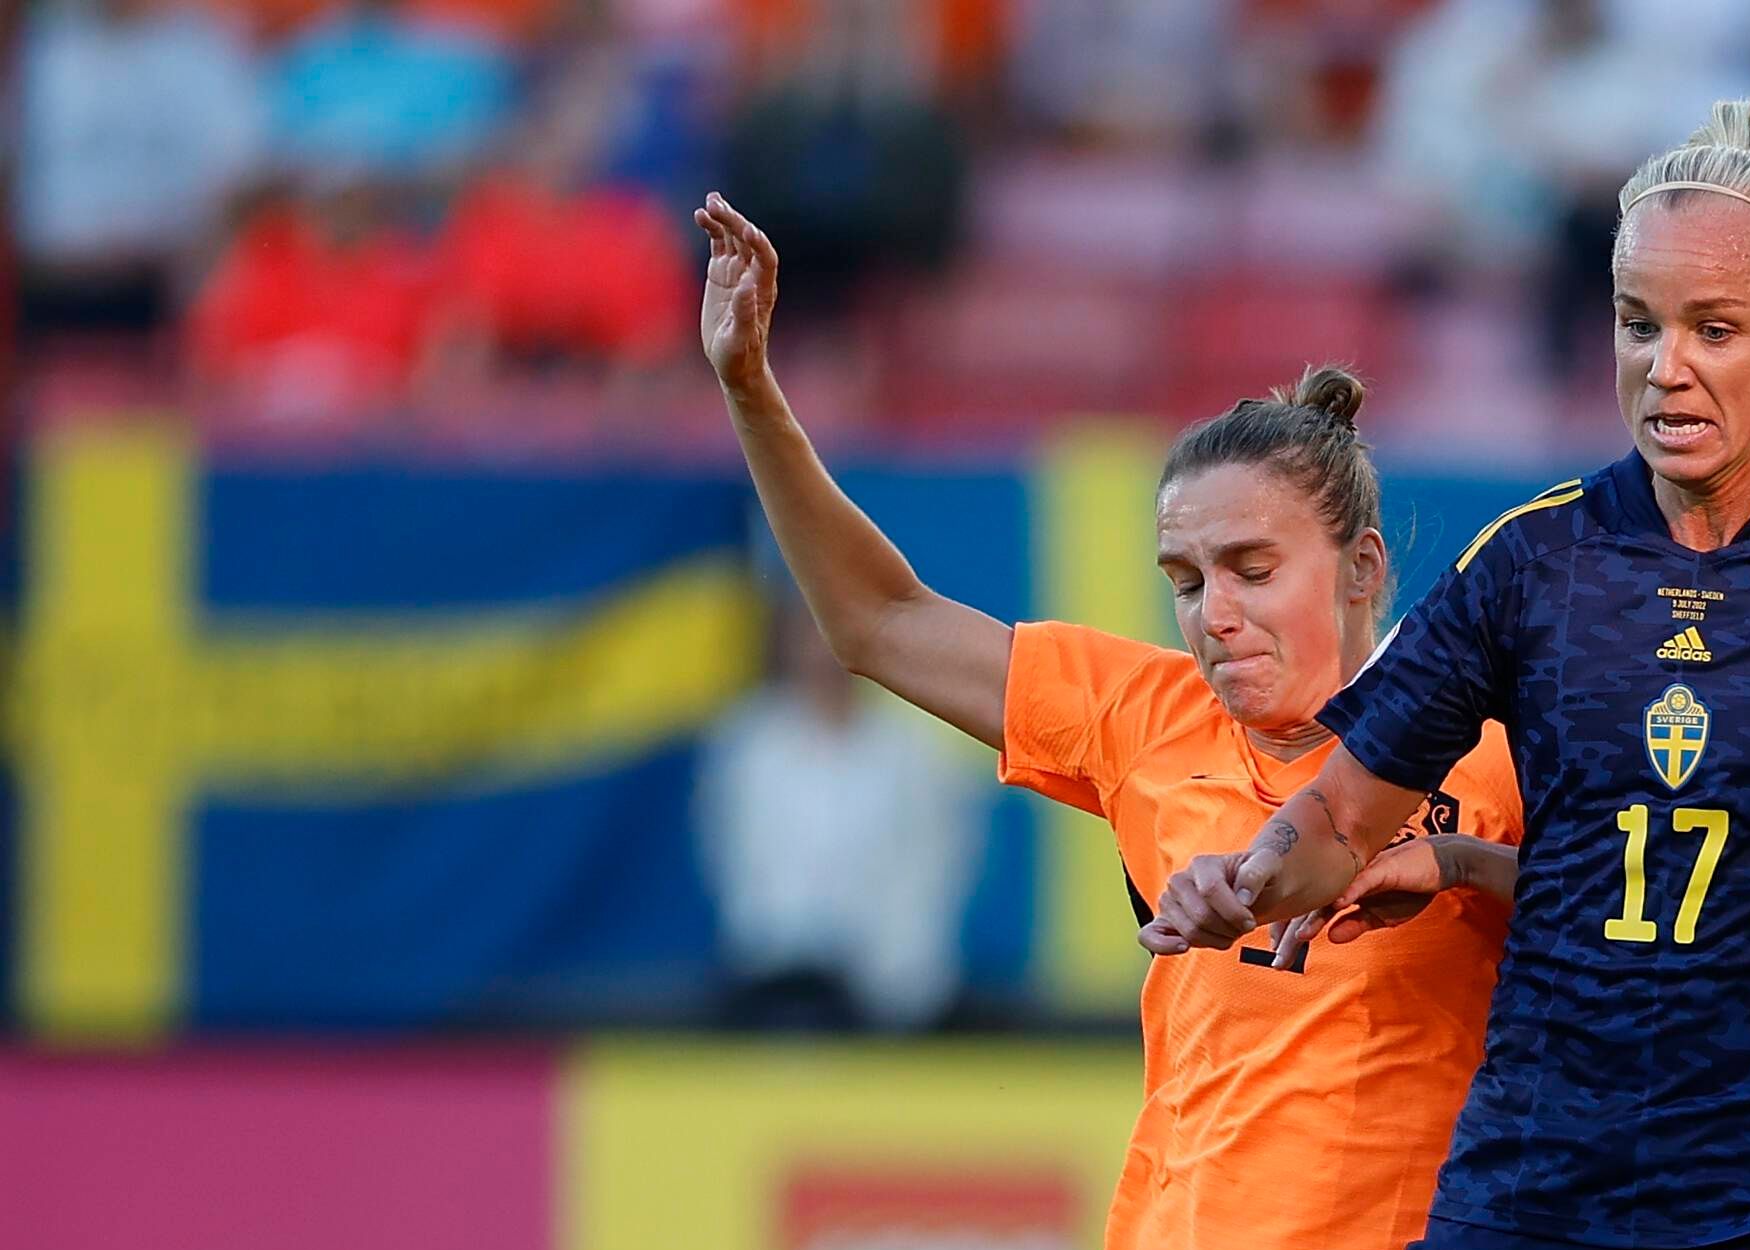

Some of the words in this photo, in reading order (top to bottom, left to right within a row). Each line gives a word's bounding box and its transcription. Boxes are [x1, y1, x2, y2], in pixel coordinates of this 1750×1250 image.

[1656, 647, 1712, 662] adidas
[1655, 715, 1699, 725] SVERIGE
[1603, 803, 1730, 945] 17
